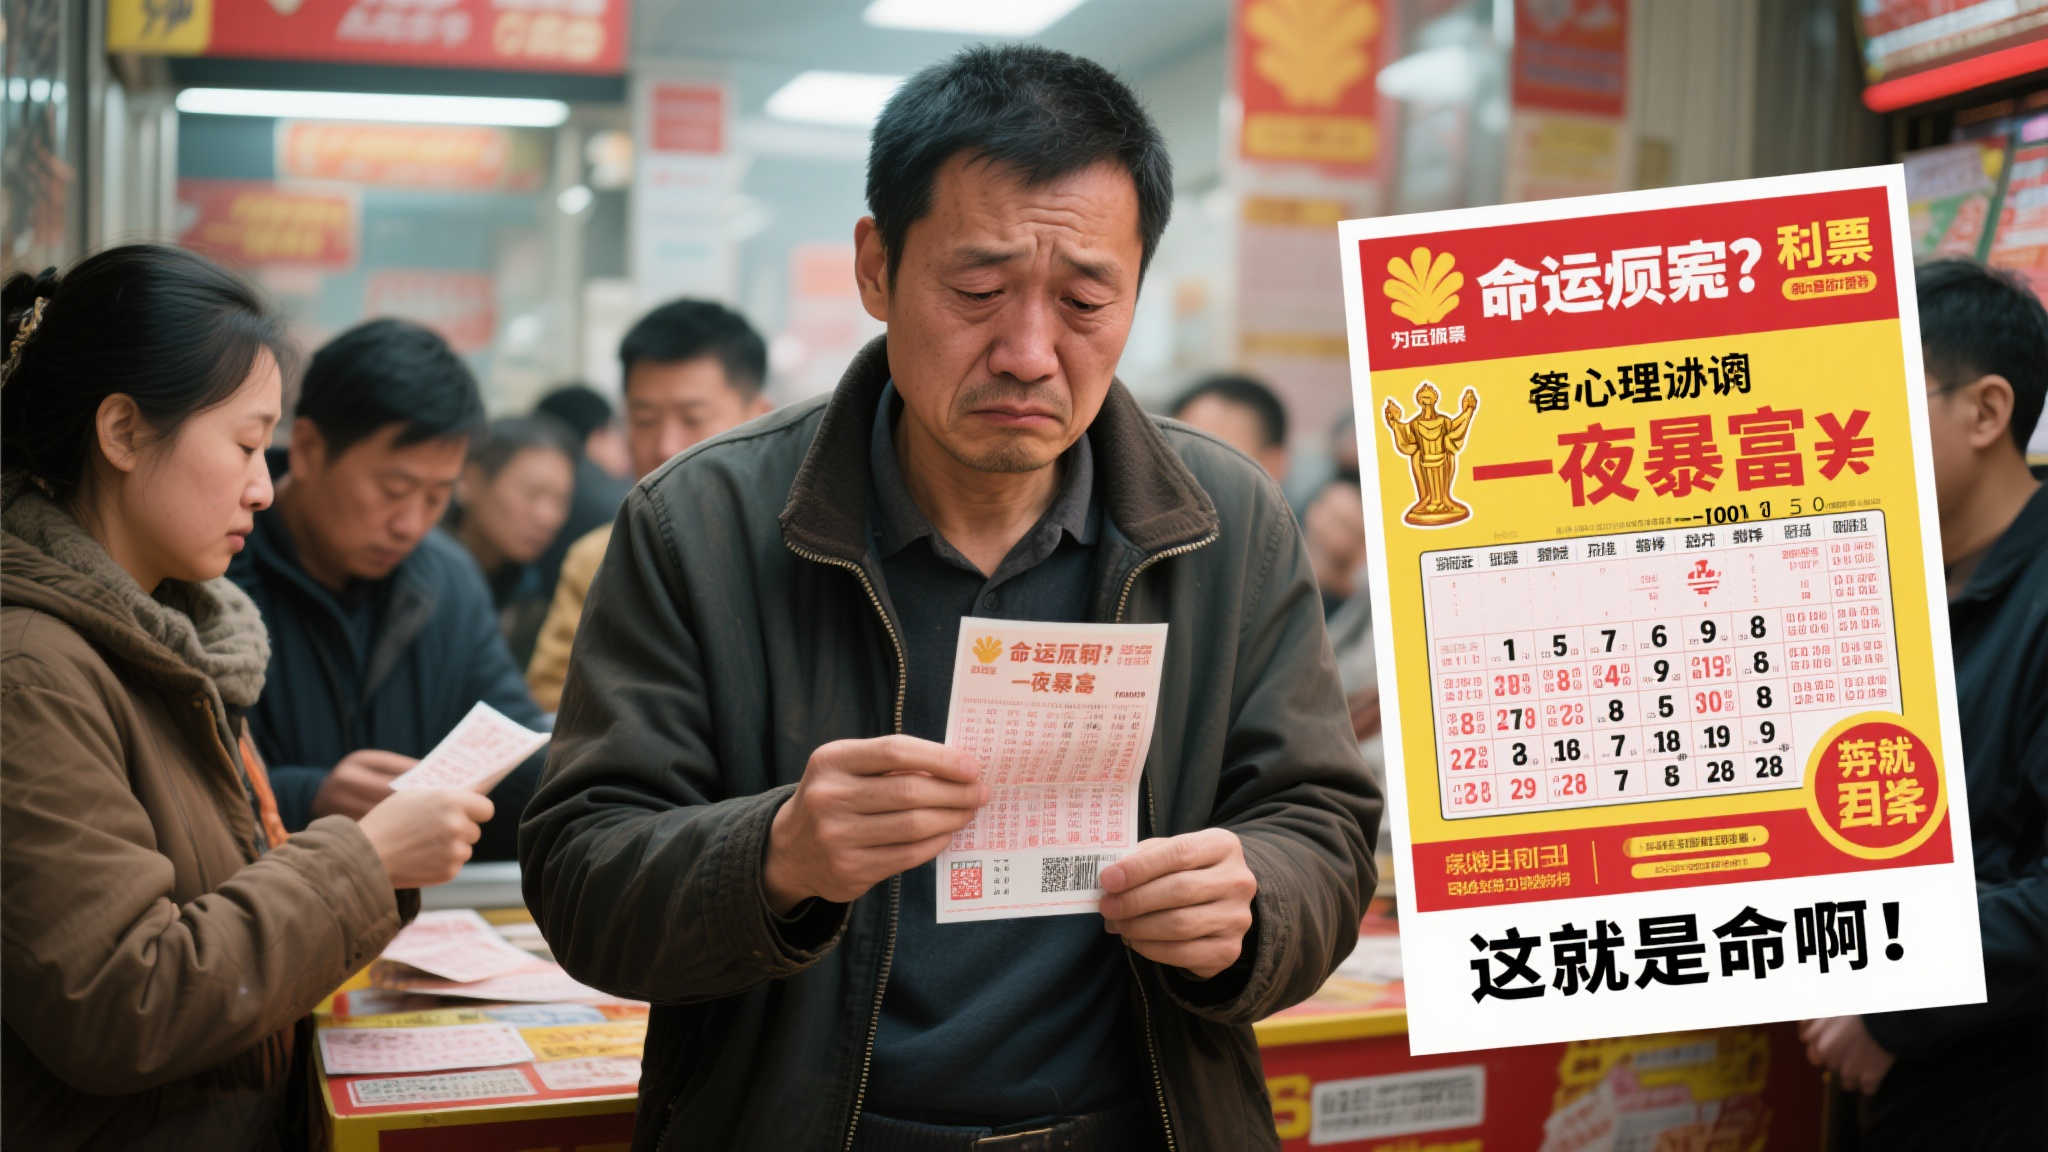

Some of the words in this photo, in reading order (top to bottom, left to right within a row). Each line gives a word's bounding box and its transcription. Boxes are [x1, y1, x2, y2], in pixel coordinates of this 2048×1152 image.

[1778, 217, 1872, 270] 利票
[1504, 640, 1514, 660] 1
[1554, 635, 1567, 656] 5
[1602, 630, 1616, 652] 7
[1652, 625, 1666, 647] 6
[1701, 621, 1716, 643] 9
[1751, 616, 1766, 638] 8
[1011, 671, 1096, 695] 一夜暴富
[1558, 670, 1569, 690] 8
[1606, 666, 1619, 686] 4
[1654, 660, 1669, 682] 9
[1703, 658, 1723, 677] 19
[1462, 713, 1474, 734] 8
[1609, 700, 1623, 721] 8
[1659, 696, 1673, 717] 5
[1698, 692, 1721, 713] 30
[1757, 687, 1772, 708] 8
[1452, 748, 1475, 770] 22
[1611, 735, 1624, 756] 7
[1655, 731, 1680, 752] 18
[1704, 726, 1730, 748] 19
[1760, 722, 1774, 743] 9
[1512, 779, 1535, 799] 29
[1615, 770, 1627, 790] 7
[1708, 760, 1734, 782] 28
[1756, 756, 1782, 777] 28
[1471, 901, 1903, 1003] 这就是命啊!
